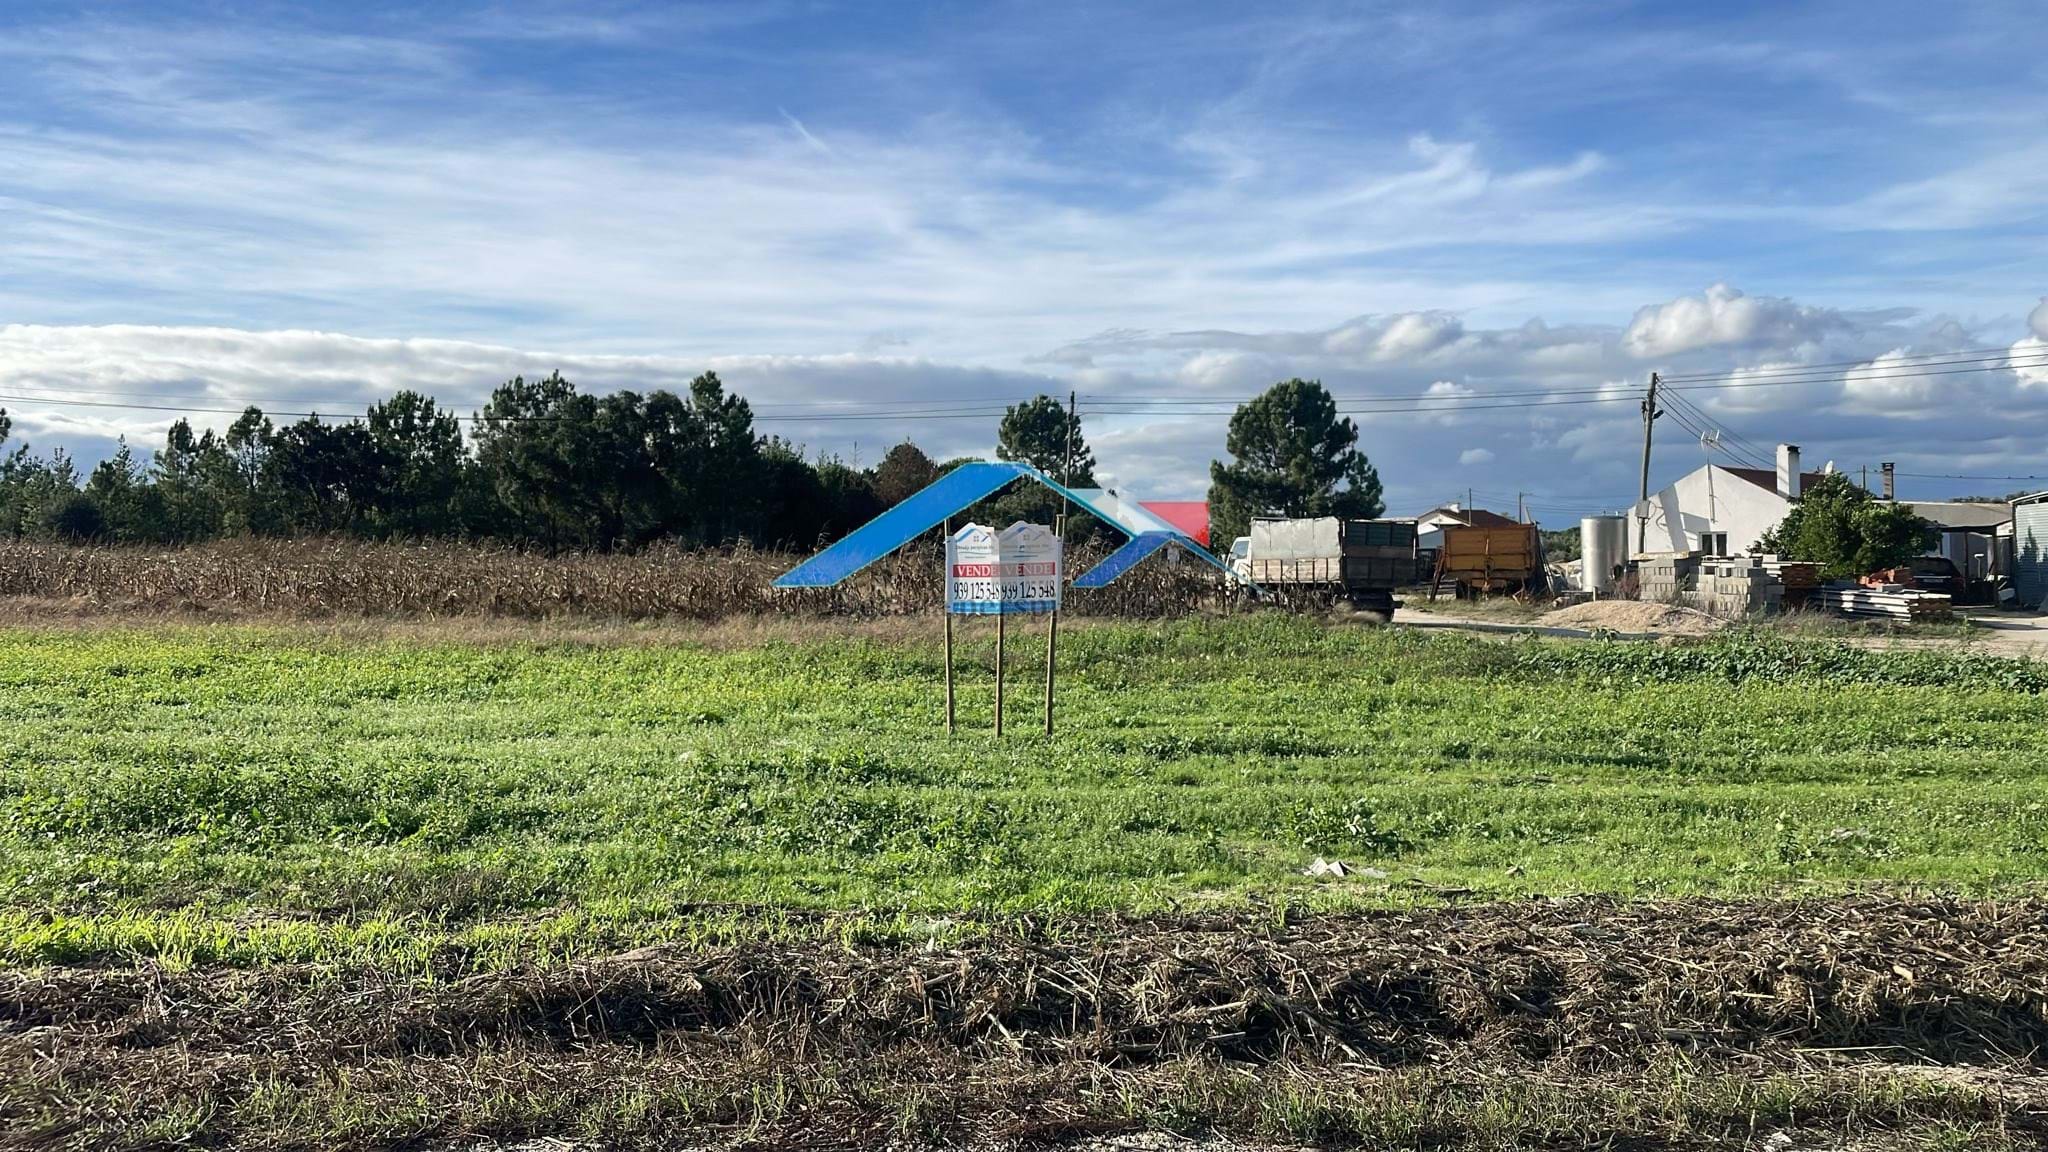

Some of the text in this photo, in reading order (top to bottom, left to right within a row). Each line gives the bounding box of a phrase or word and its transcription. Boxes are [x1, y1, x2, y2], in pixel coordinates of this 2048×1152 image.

[957, 565, 1000, 577] VENDE
[1005, 564, 1051, 576] VENDE
[953, 582, 969, 599] 939
[971, 582, 985, 599] 125
[1001, 580, 1055, 599] 939 125 548
